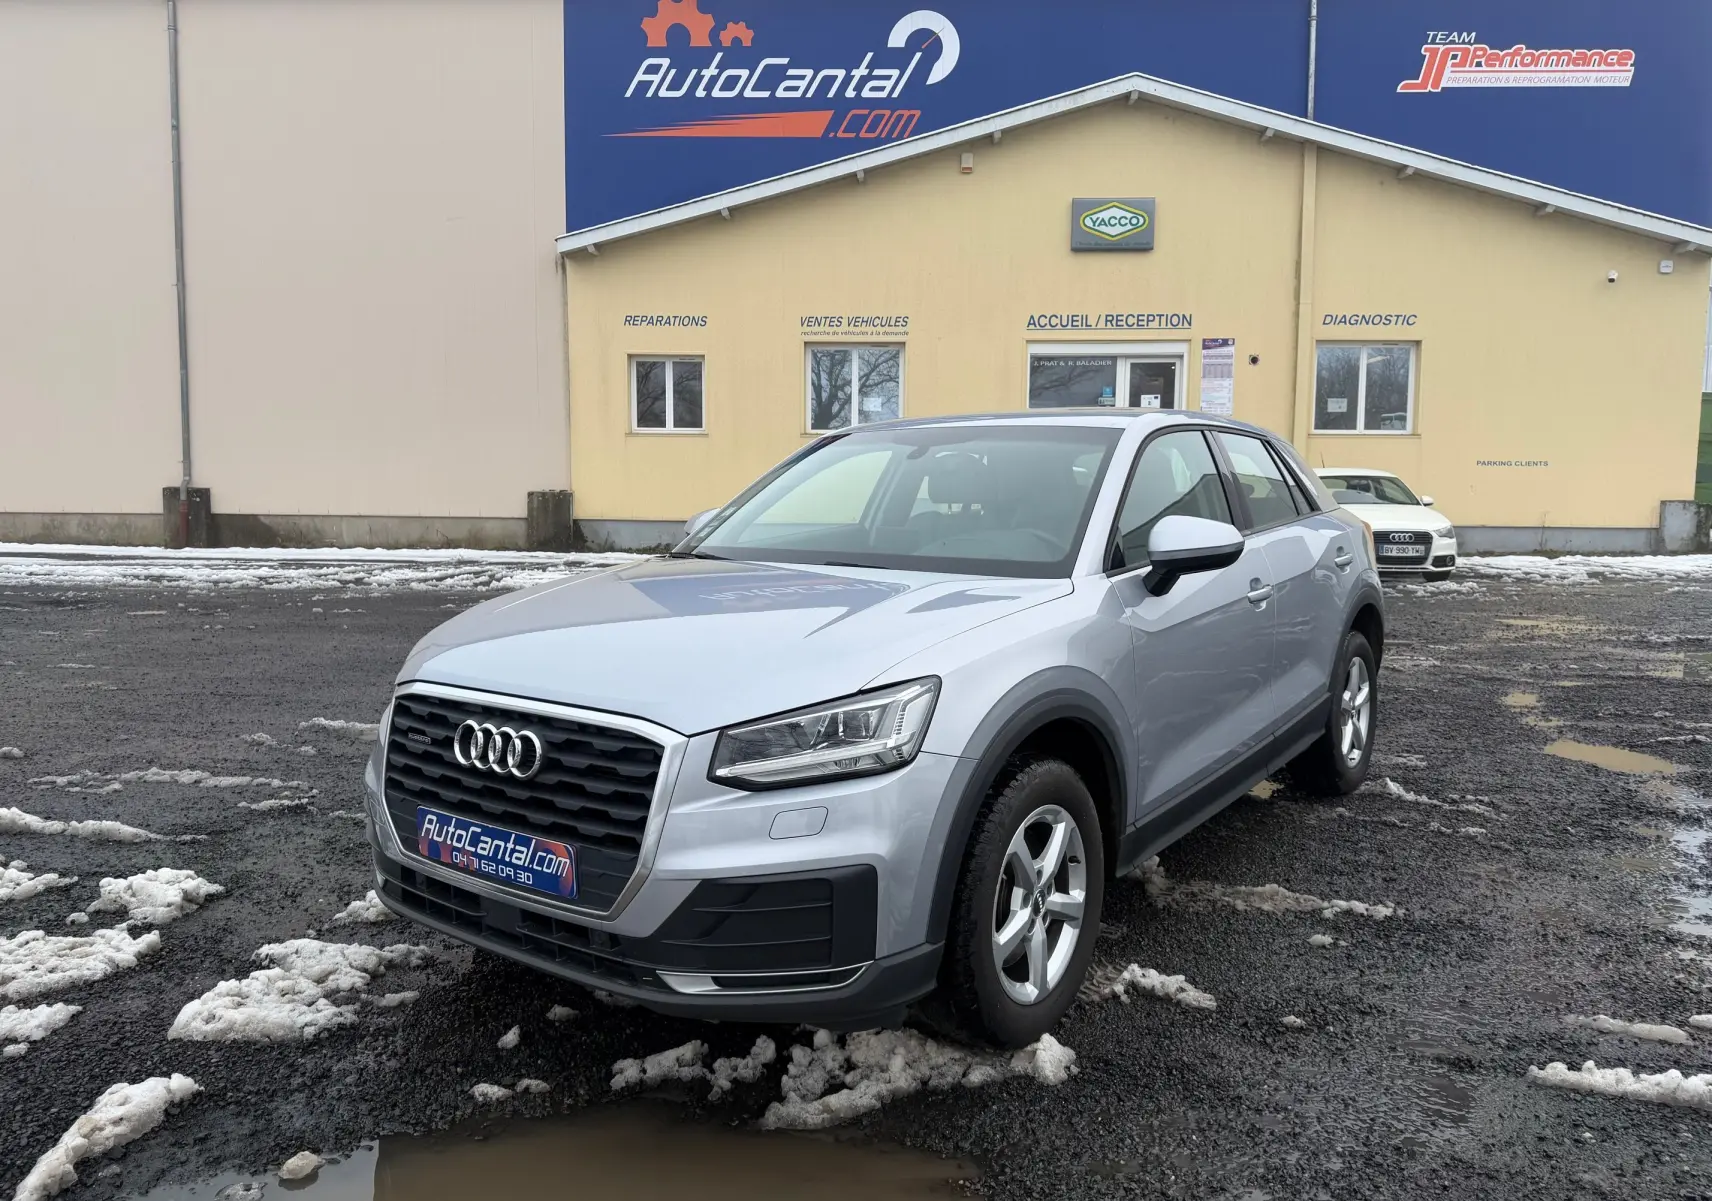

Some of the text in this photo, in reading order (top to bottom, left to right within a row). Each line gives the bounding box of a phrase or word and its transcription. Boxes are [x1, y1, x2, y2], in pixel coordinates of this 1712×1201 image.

[1426, 31, 1476, 43] TEAM
[624, 51, 924, 98] AutoCantal
[1446, 75, 1631, 85] PREPARATION & REPROGRAMATION MOTEUR
[1088, 215, 1141, 228] YACCO
[623, 315, 708, 327] REPARATIONS
[800, 315, 910, 328] VENTES VEHICULES
[1026, 313, 1193, 328] ACCUEIL / RECEPTION
[1322, 314, 1418, 326] DIAGNOSTIC
[421, 814, 570, 878] AutoCantal.com
[452, 851, 533, 885] 04 71 62 09 30
